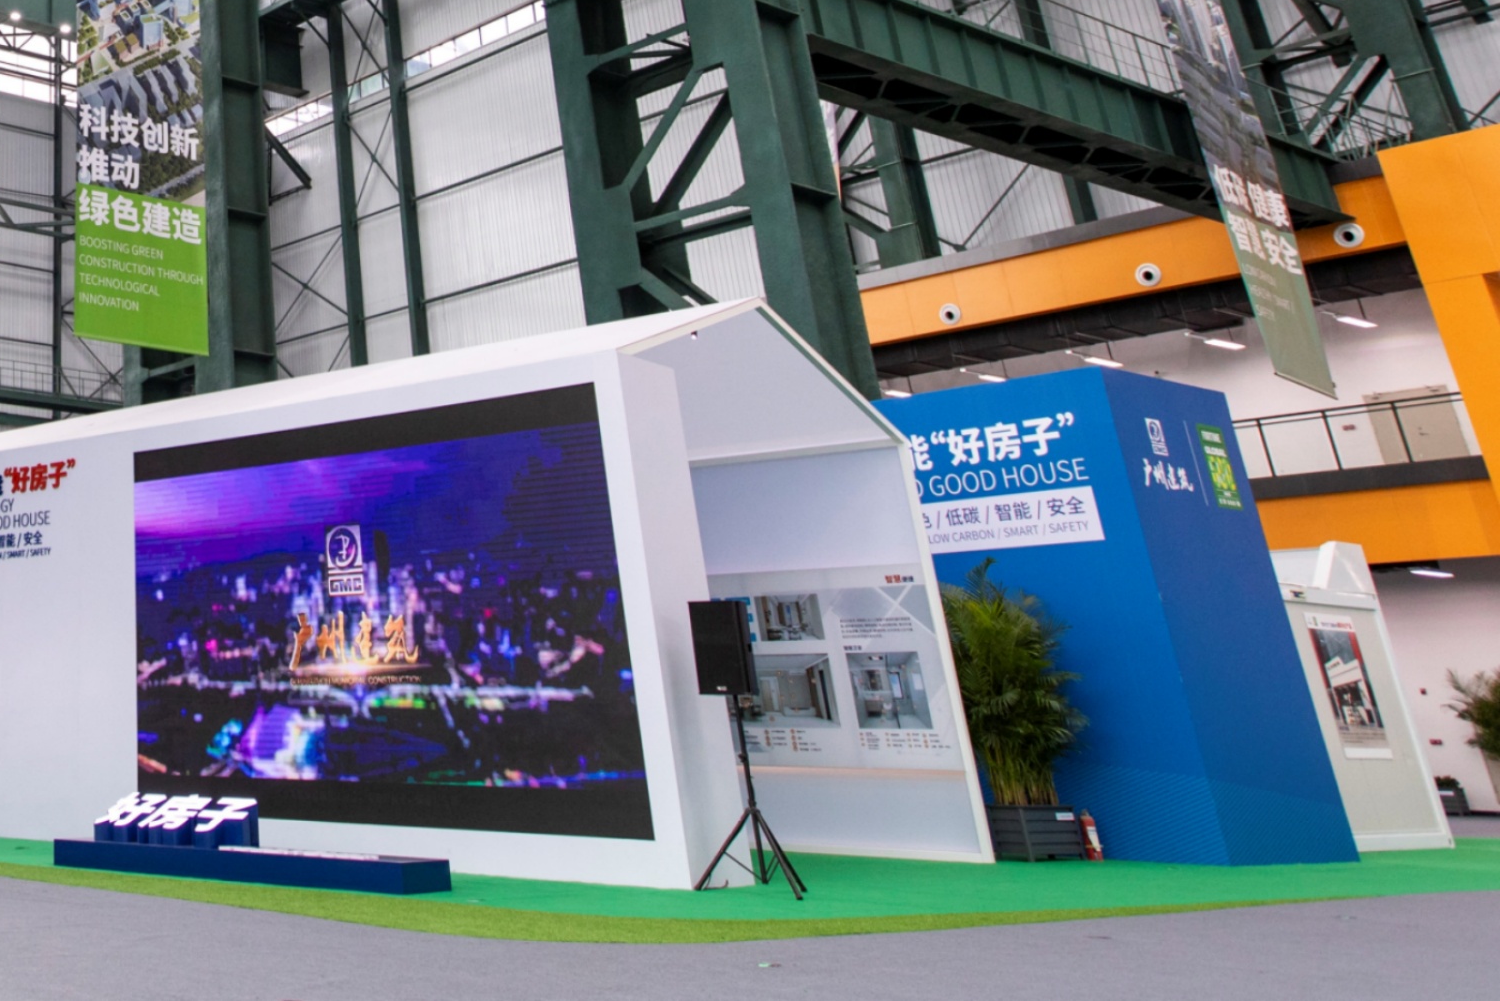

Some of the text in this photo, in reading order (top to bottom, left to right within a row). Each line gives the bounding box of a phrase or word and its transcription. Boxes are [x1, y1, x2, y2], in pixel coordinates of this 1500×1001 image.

[79, 104, 199, 160] 科技创新
[77, 145, 140, 189] 推动
[79, 189, 201, 245] 绿色建造
[80, 235, 164, 260] BOOSTING GREEN
[79, 254, 204, 285] CONSTRUCTION THROUGH
[79, 272, 160, 297] TECHNOLOGICAL
[79, 292, 139, 311] INNOVATION
[929, 469, 997, 497] GOOD
[1002, 457, 1089, 489] HOUSE
[13, 510, 51, 528] HOUSE
[946, 507, 981, 527] 低碳
[994, 501, 1032, 522] 智能
[1047, 496, 1086, 517] 安全
[23, 530, 42, 546] 安全
[928, 533, 950, 544] LOW
[952, 529, 995, 543] CARBON
[1004, 524, 1039, 538] SMART
[1049, 520, 1089, 534] SAFETY
[94, 792, 258, 832] 好房子
